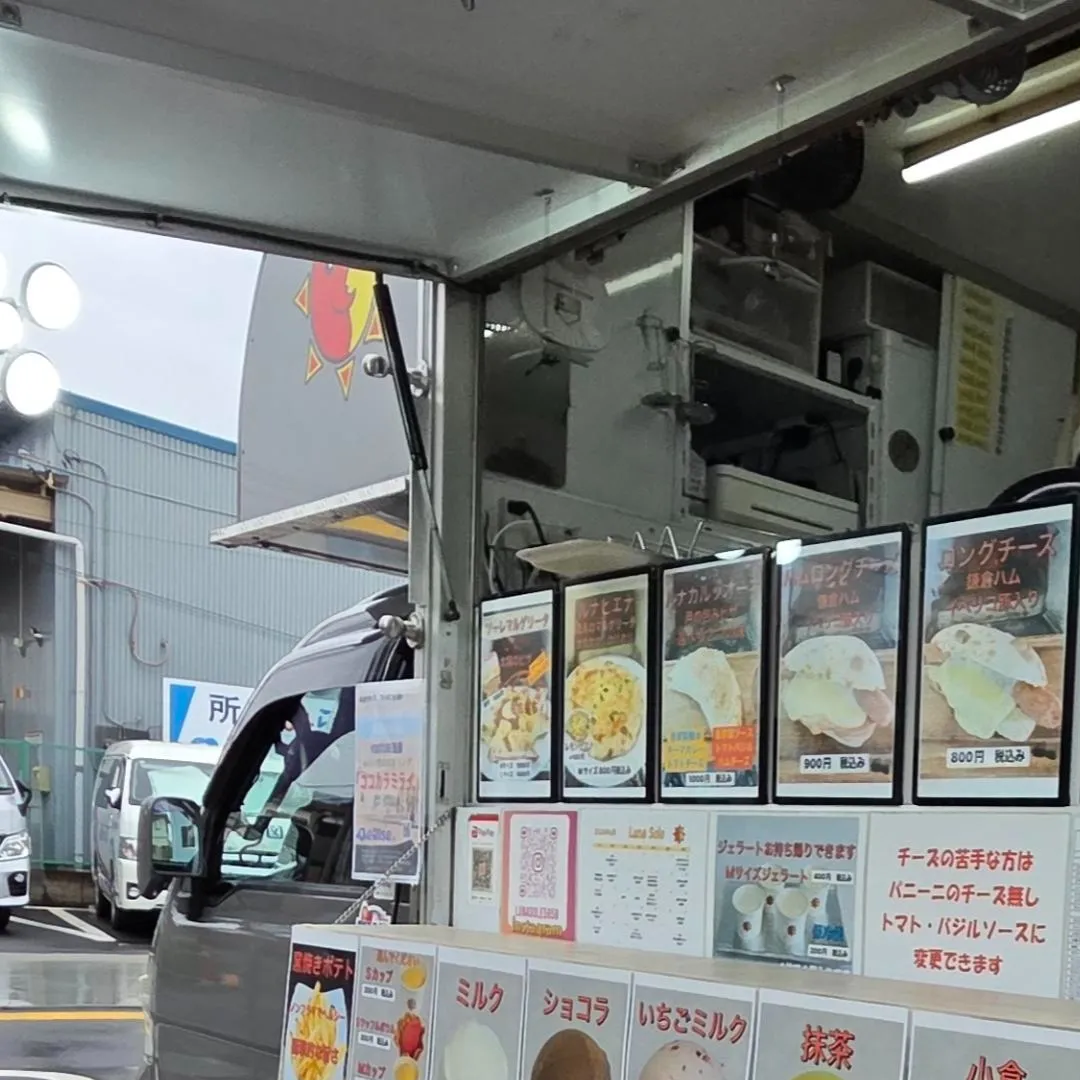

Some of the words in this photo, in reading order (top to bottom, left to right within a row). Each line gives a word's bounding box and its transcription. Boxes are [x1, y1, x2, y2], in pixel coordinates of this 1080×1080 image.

[209, 694, 241, 724] 所
[803, 757, 831, 770] 900円
[950, 751, 985, 764] 800円
[994, 750, 1026, 763] 税込み
[897, 847, 1035, 872] チーズの苦手な方は
[882, 912, 1046, 944] トマト・バジルソースに
[913, 948, 1004, 976] 変更できます
[456, 977, 505, 1013] ミルク
[543, 988, 611, 1027] ショコラ
[638, 1000, 748, 1044] いちごミルク
[800, 1023, 855, 1071] 抹茶
